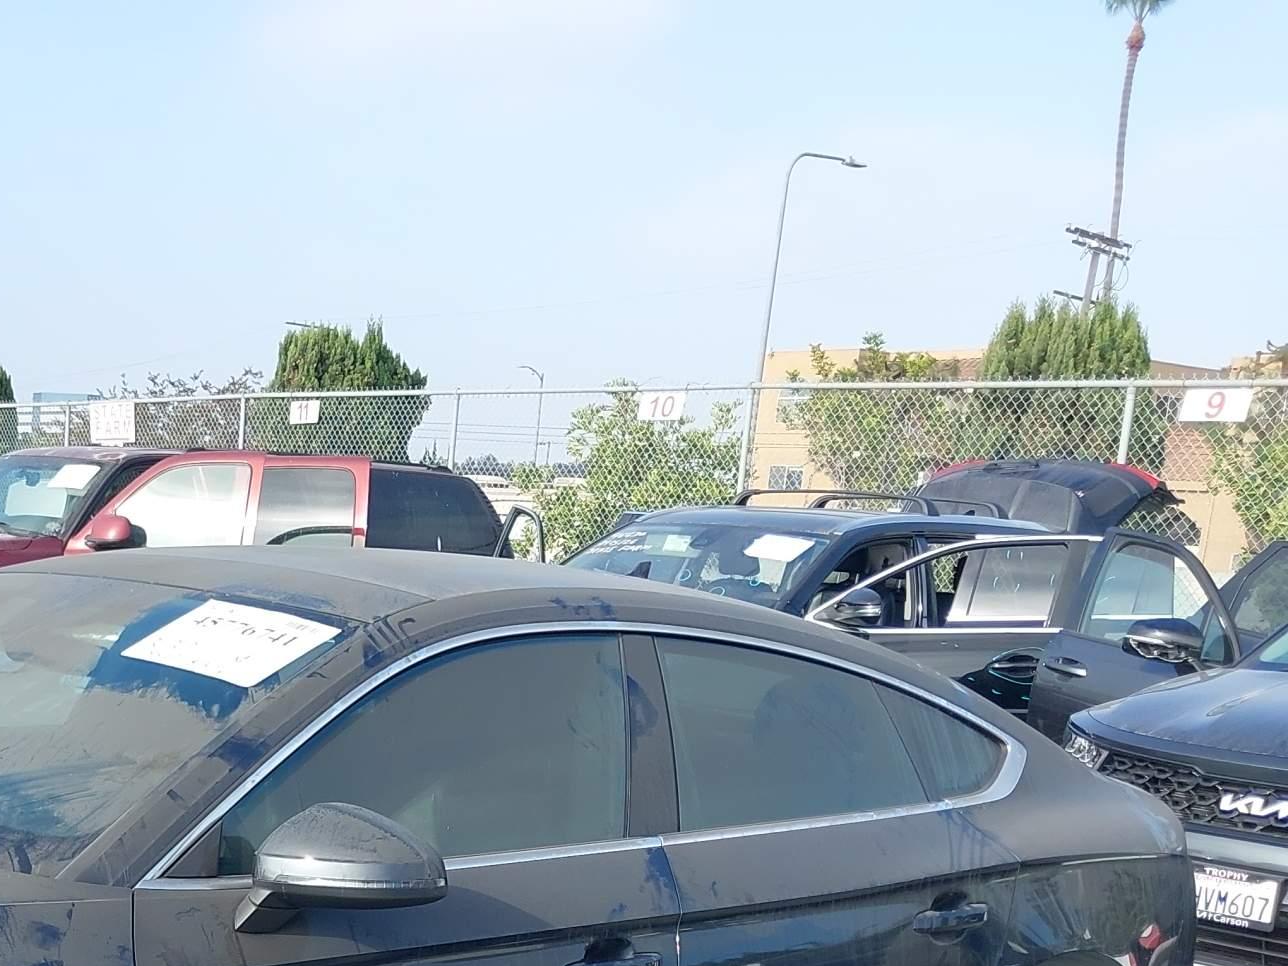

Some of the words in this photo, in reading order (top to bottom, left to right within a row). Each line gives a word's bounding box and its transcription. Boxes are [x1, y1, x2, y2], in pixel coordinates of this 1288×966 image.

[297, 402, 309, 422] 11
[650, 395, 675, 418] 10
[1205, 391, 1226, 419] 9
[1203, 867, 1249, 881] TROPHY
[1213, 913, 1249, 928] Carson
